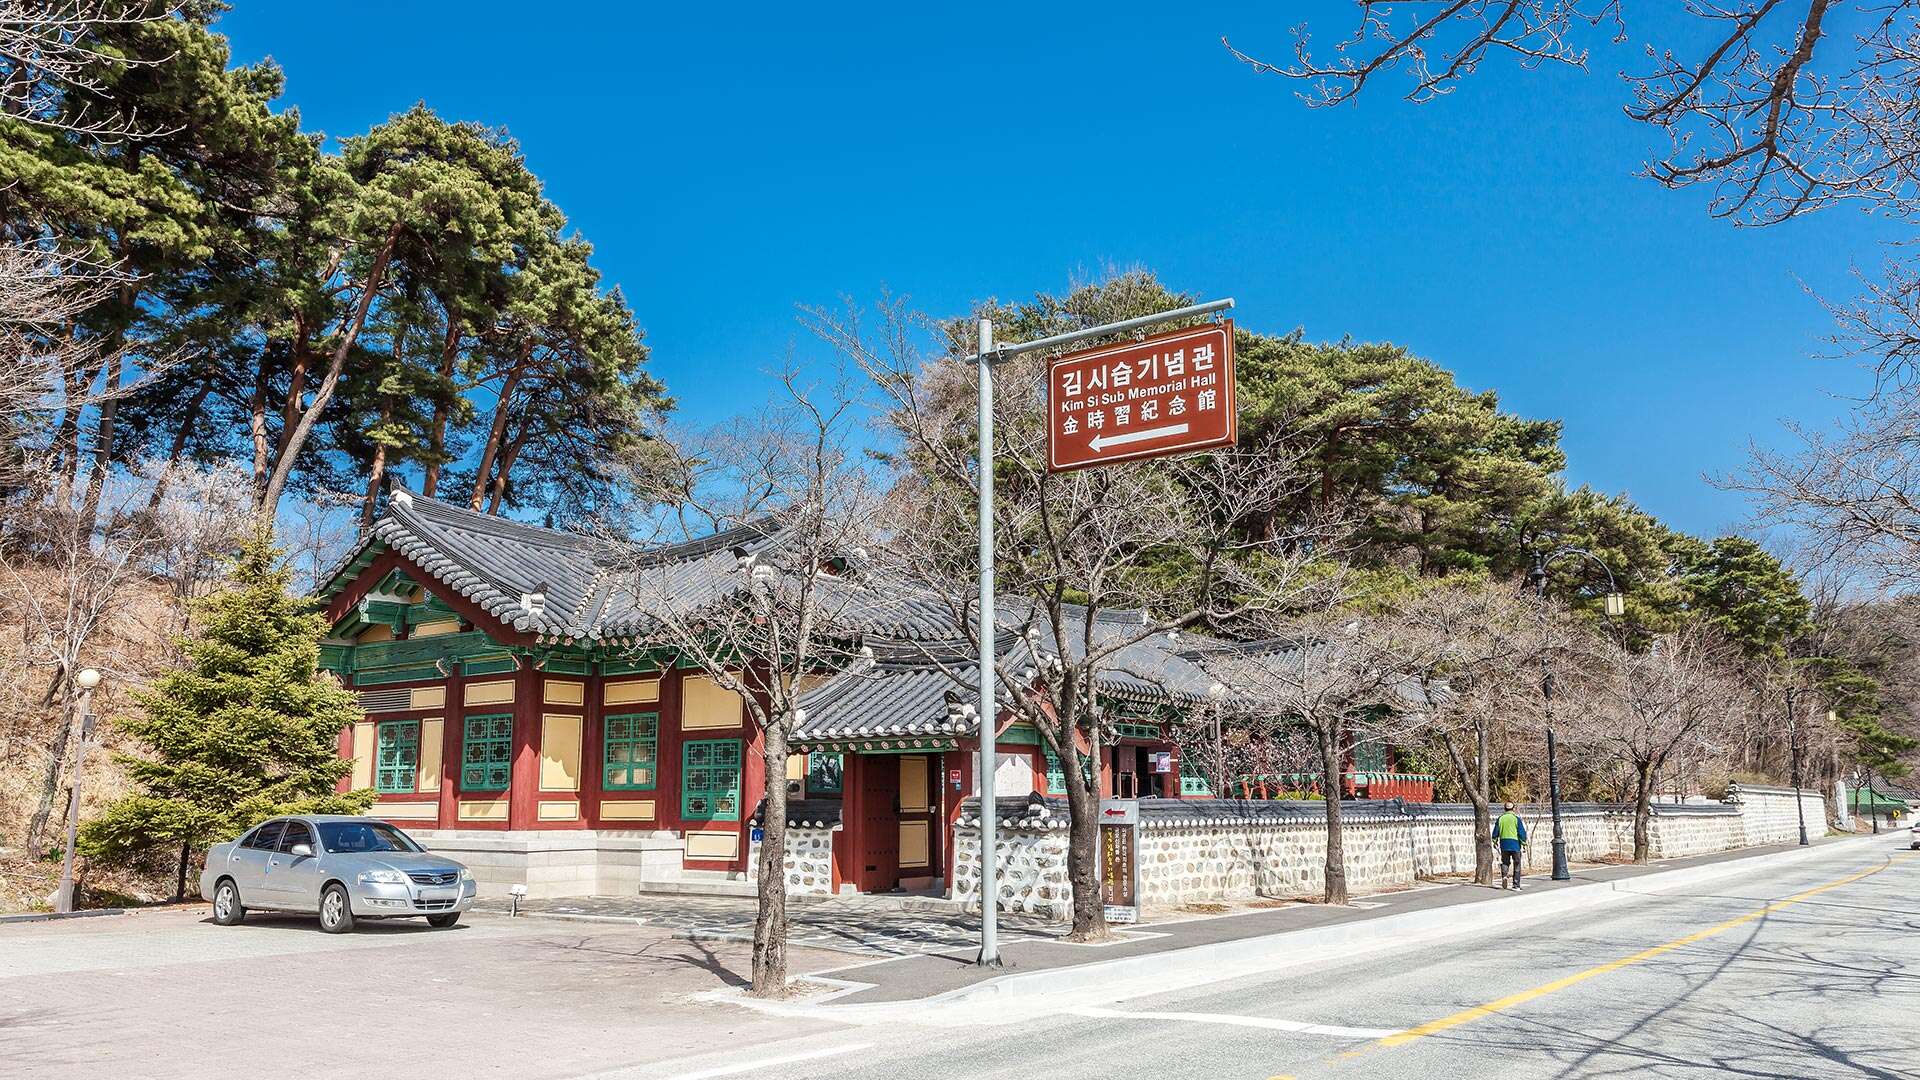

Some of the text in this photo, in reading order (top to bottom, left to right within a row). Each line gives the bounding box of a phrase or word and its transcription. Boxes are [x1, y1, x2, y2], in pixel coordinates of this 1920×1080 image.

[1061, 372, 1216, 413] Kim Si Sub Memorial Hall
[1062, 343, 1215, 397] 김시습기념관
[1063, 388, 1216, 435] 金時習紀念館
